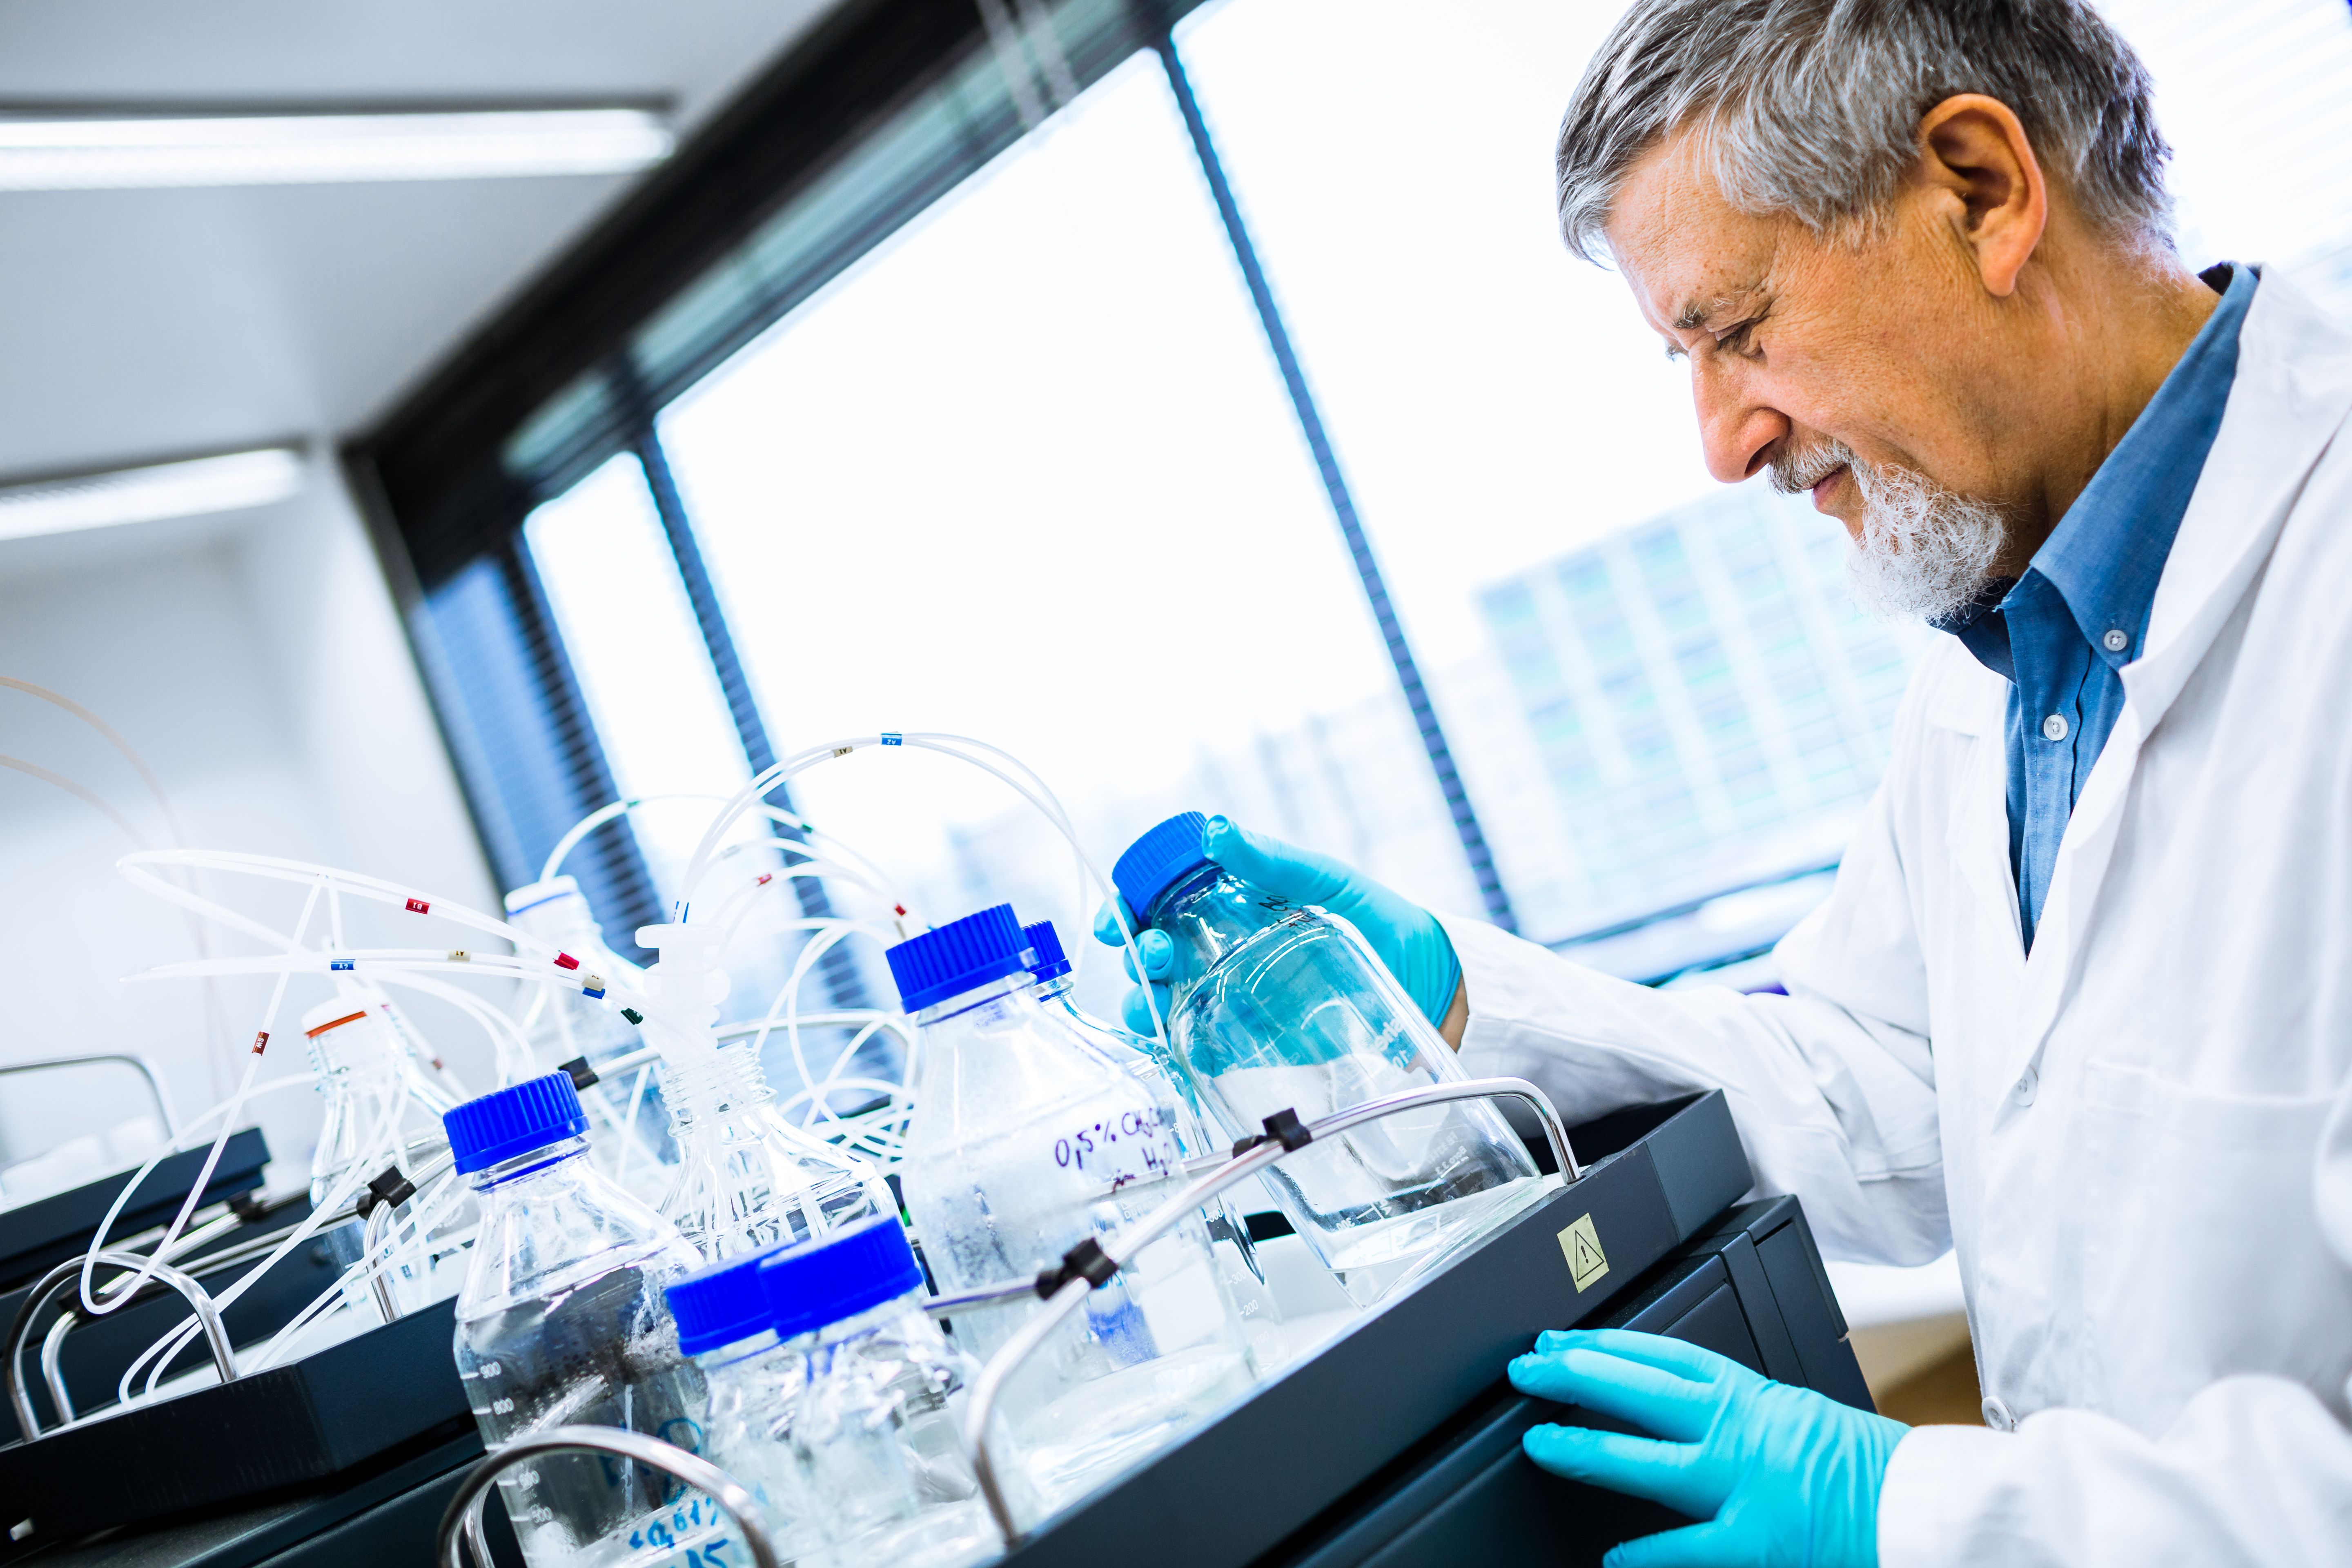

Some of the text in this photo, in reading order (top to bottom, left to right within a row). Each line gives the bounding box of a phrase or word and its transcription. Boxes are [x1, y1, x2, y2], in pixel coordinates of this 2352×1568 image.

[412, 902, 423, 911] B1
[255, 1037, 264, 1049] SW
[1209, 1207, 1223, 1223] 500
[1231, 1269, 1247, 1285] 300
[1243, 1299, 1259, 1316] 200
[1255, 1330, 1270, 1347] 100
[480, 1361, 502, 1379] 900
[493, 1397, 514, 1415] 800
